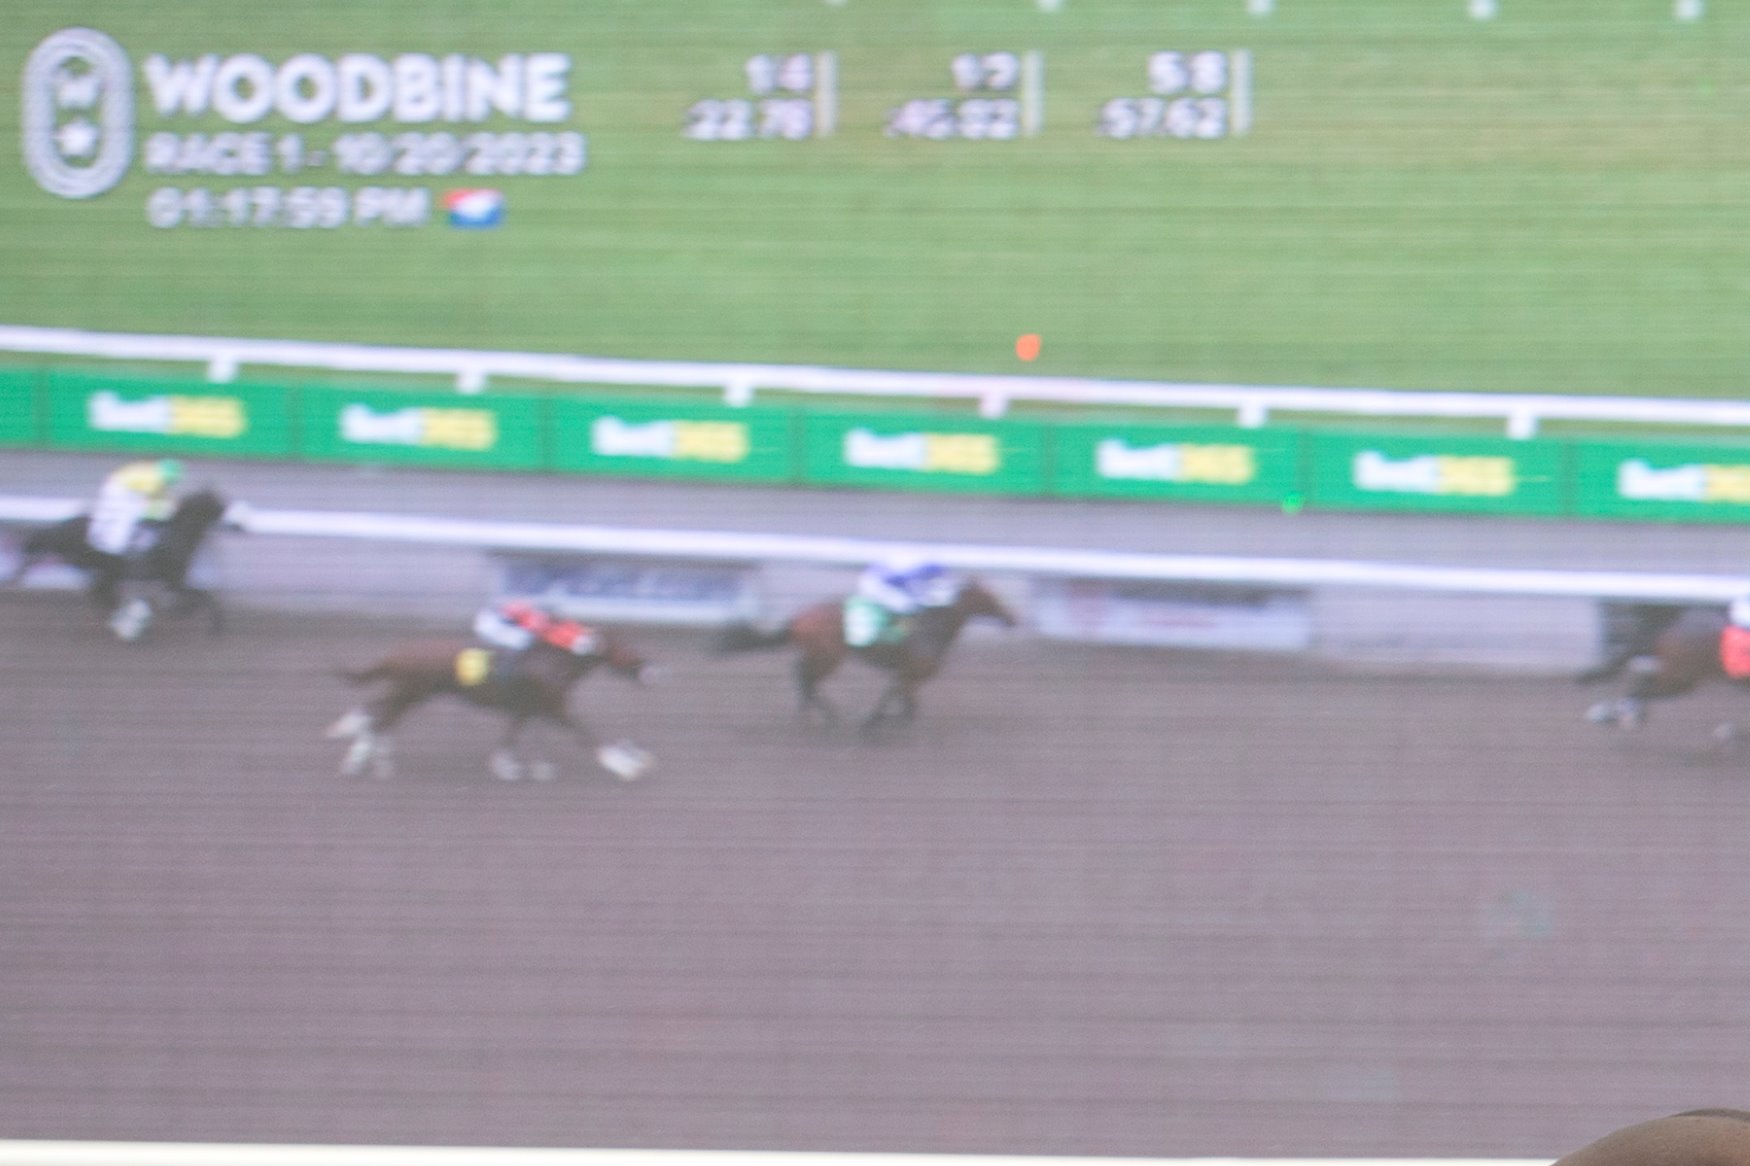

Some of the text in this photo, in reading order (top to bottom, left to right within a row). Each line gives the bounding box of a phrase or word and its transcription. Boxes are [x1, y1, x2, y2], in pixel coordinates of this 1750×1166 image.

[142, 53, 571, 123] WOODBINE
[144, 131, 272, 175] RACE
[277, 131, 300, 173] 1
[353, 186, 432, 227] PM
